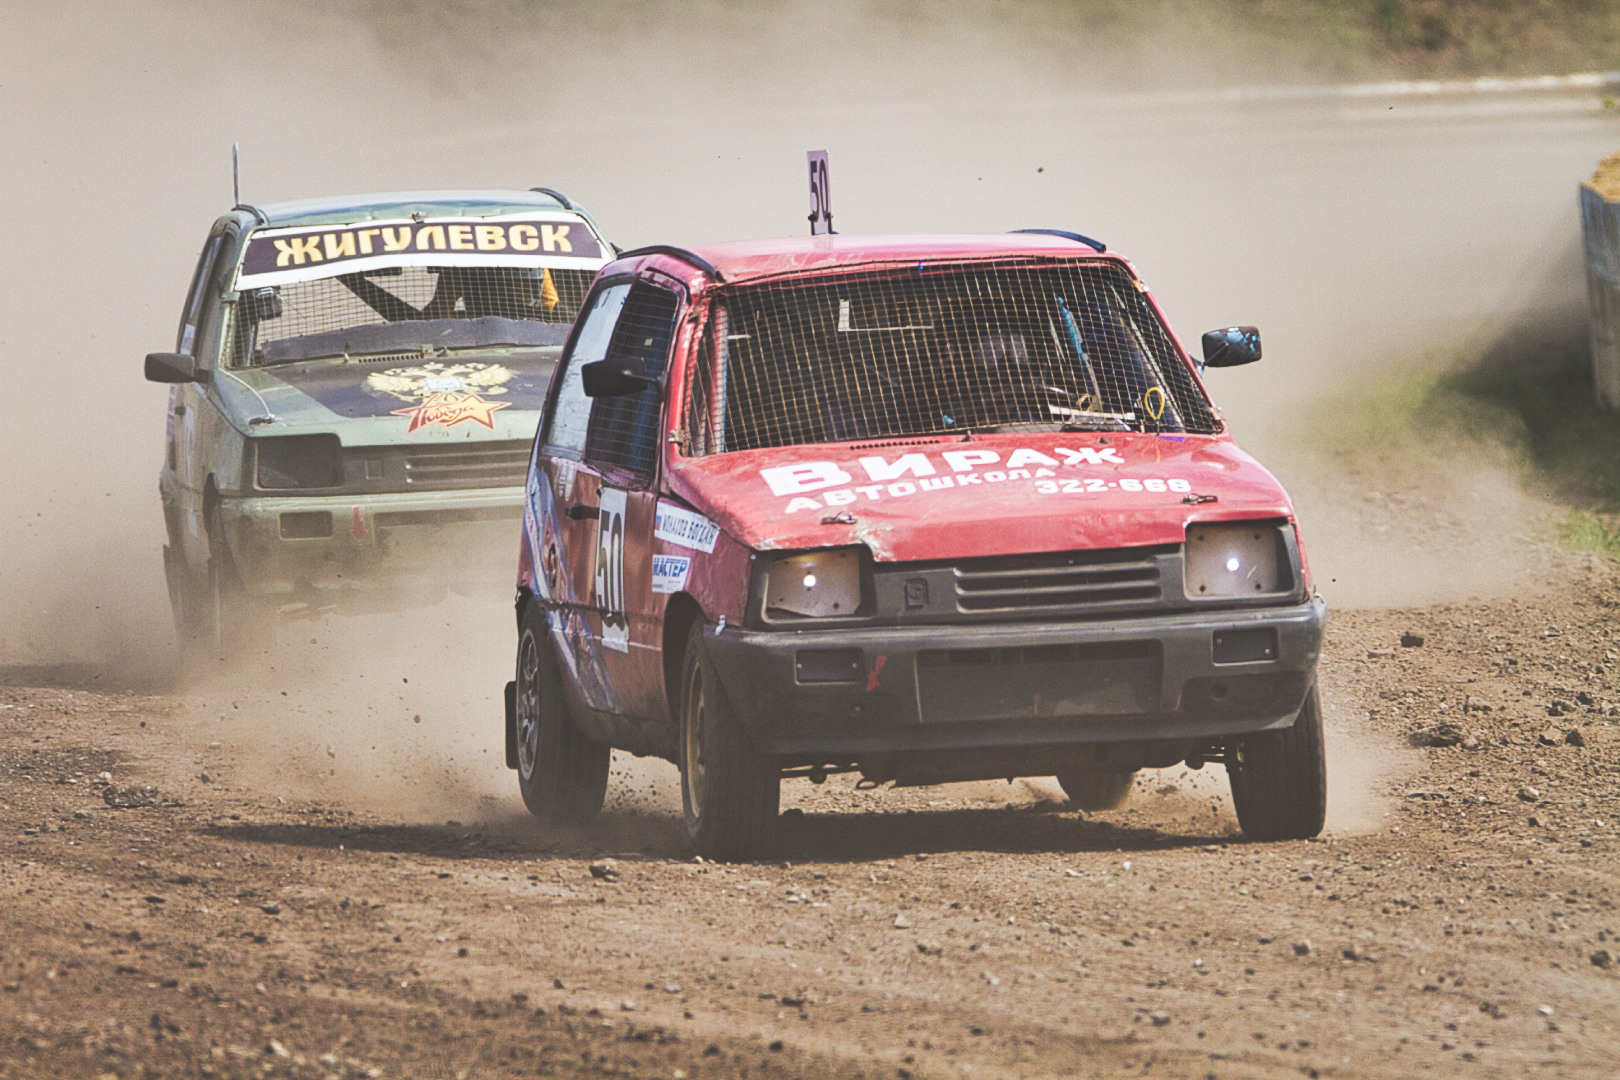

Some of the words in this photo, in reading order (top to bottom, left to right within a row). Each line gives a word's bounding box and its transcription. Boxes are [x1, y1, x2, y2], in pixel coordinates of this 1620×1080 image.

[810, 158, 828, 222] 50
[273, 224, 573, 267] ЖИГУЛЕВСК
[760, 447, 1125, 496] ВИРАЖ
[785, 467, 1056, 514] АВТОШКОЛА
[1034, 479, 1192, 494] 322-668
[597, 509, 626, 631] 50
